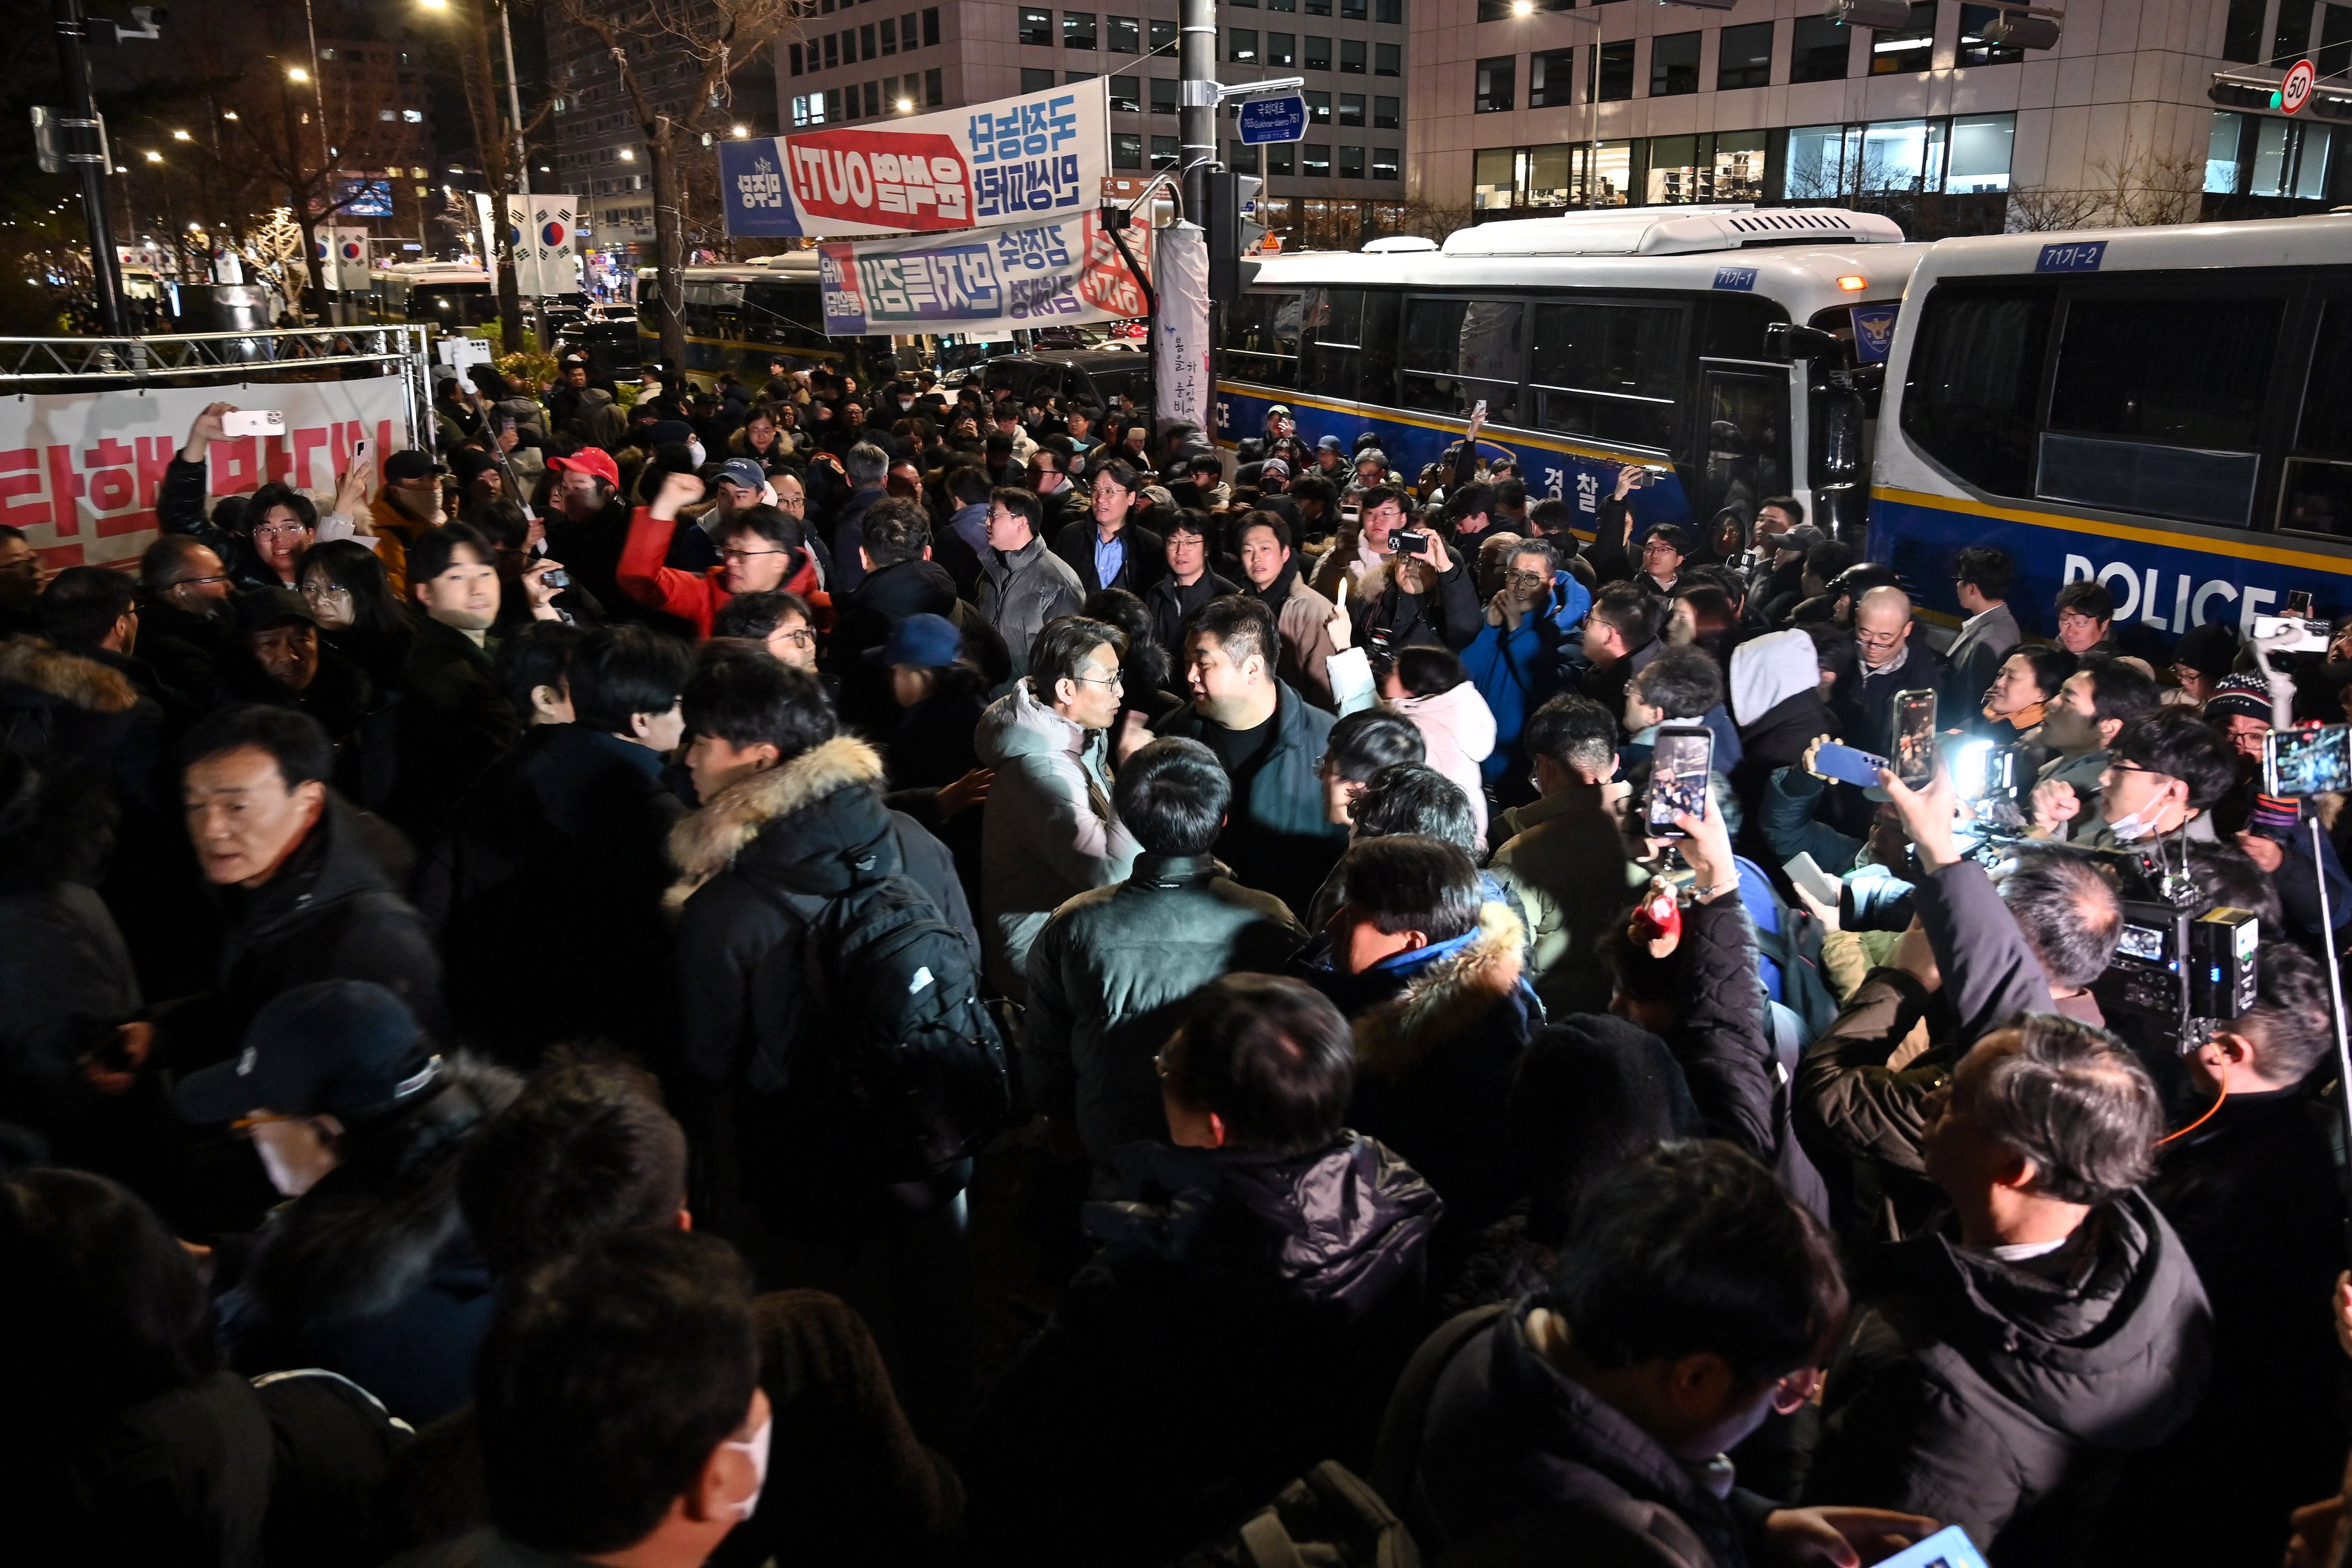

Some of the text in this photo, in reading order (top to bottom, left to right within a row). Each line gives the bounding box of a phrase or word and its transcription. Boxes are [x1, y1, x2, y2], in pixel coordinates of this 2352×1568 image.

[2288, 76, 2306, 99] 50
[1257, 102, 1286, 118] 국회대로
[1289, 113, 1300, 124] 761
[2045, 246, 2098, 267] 71기-2
[1719, 271, 1752, 286] 71기-1
[1544, 467, 1599, 513] 경찰
